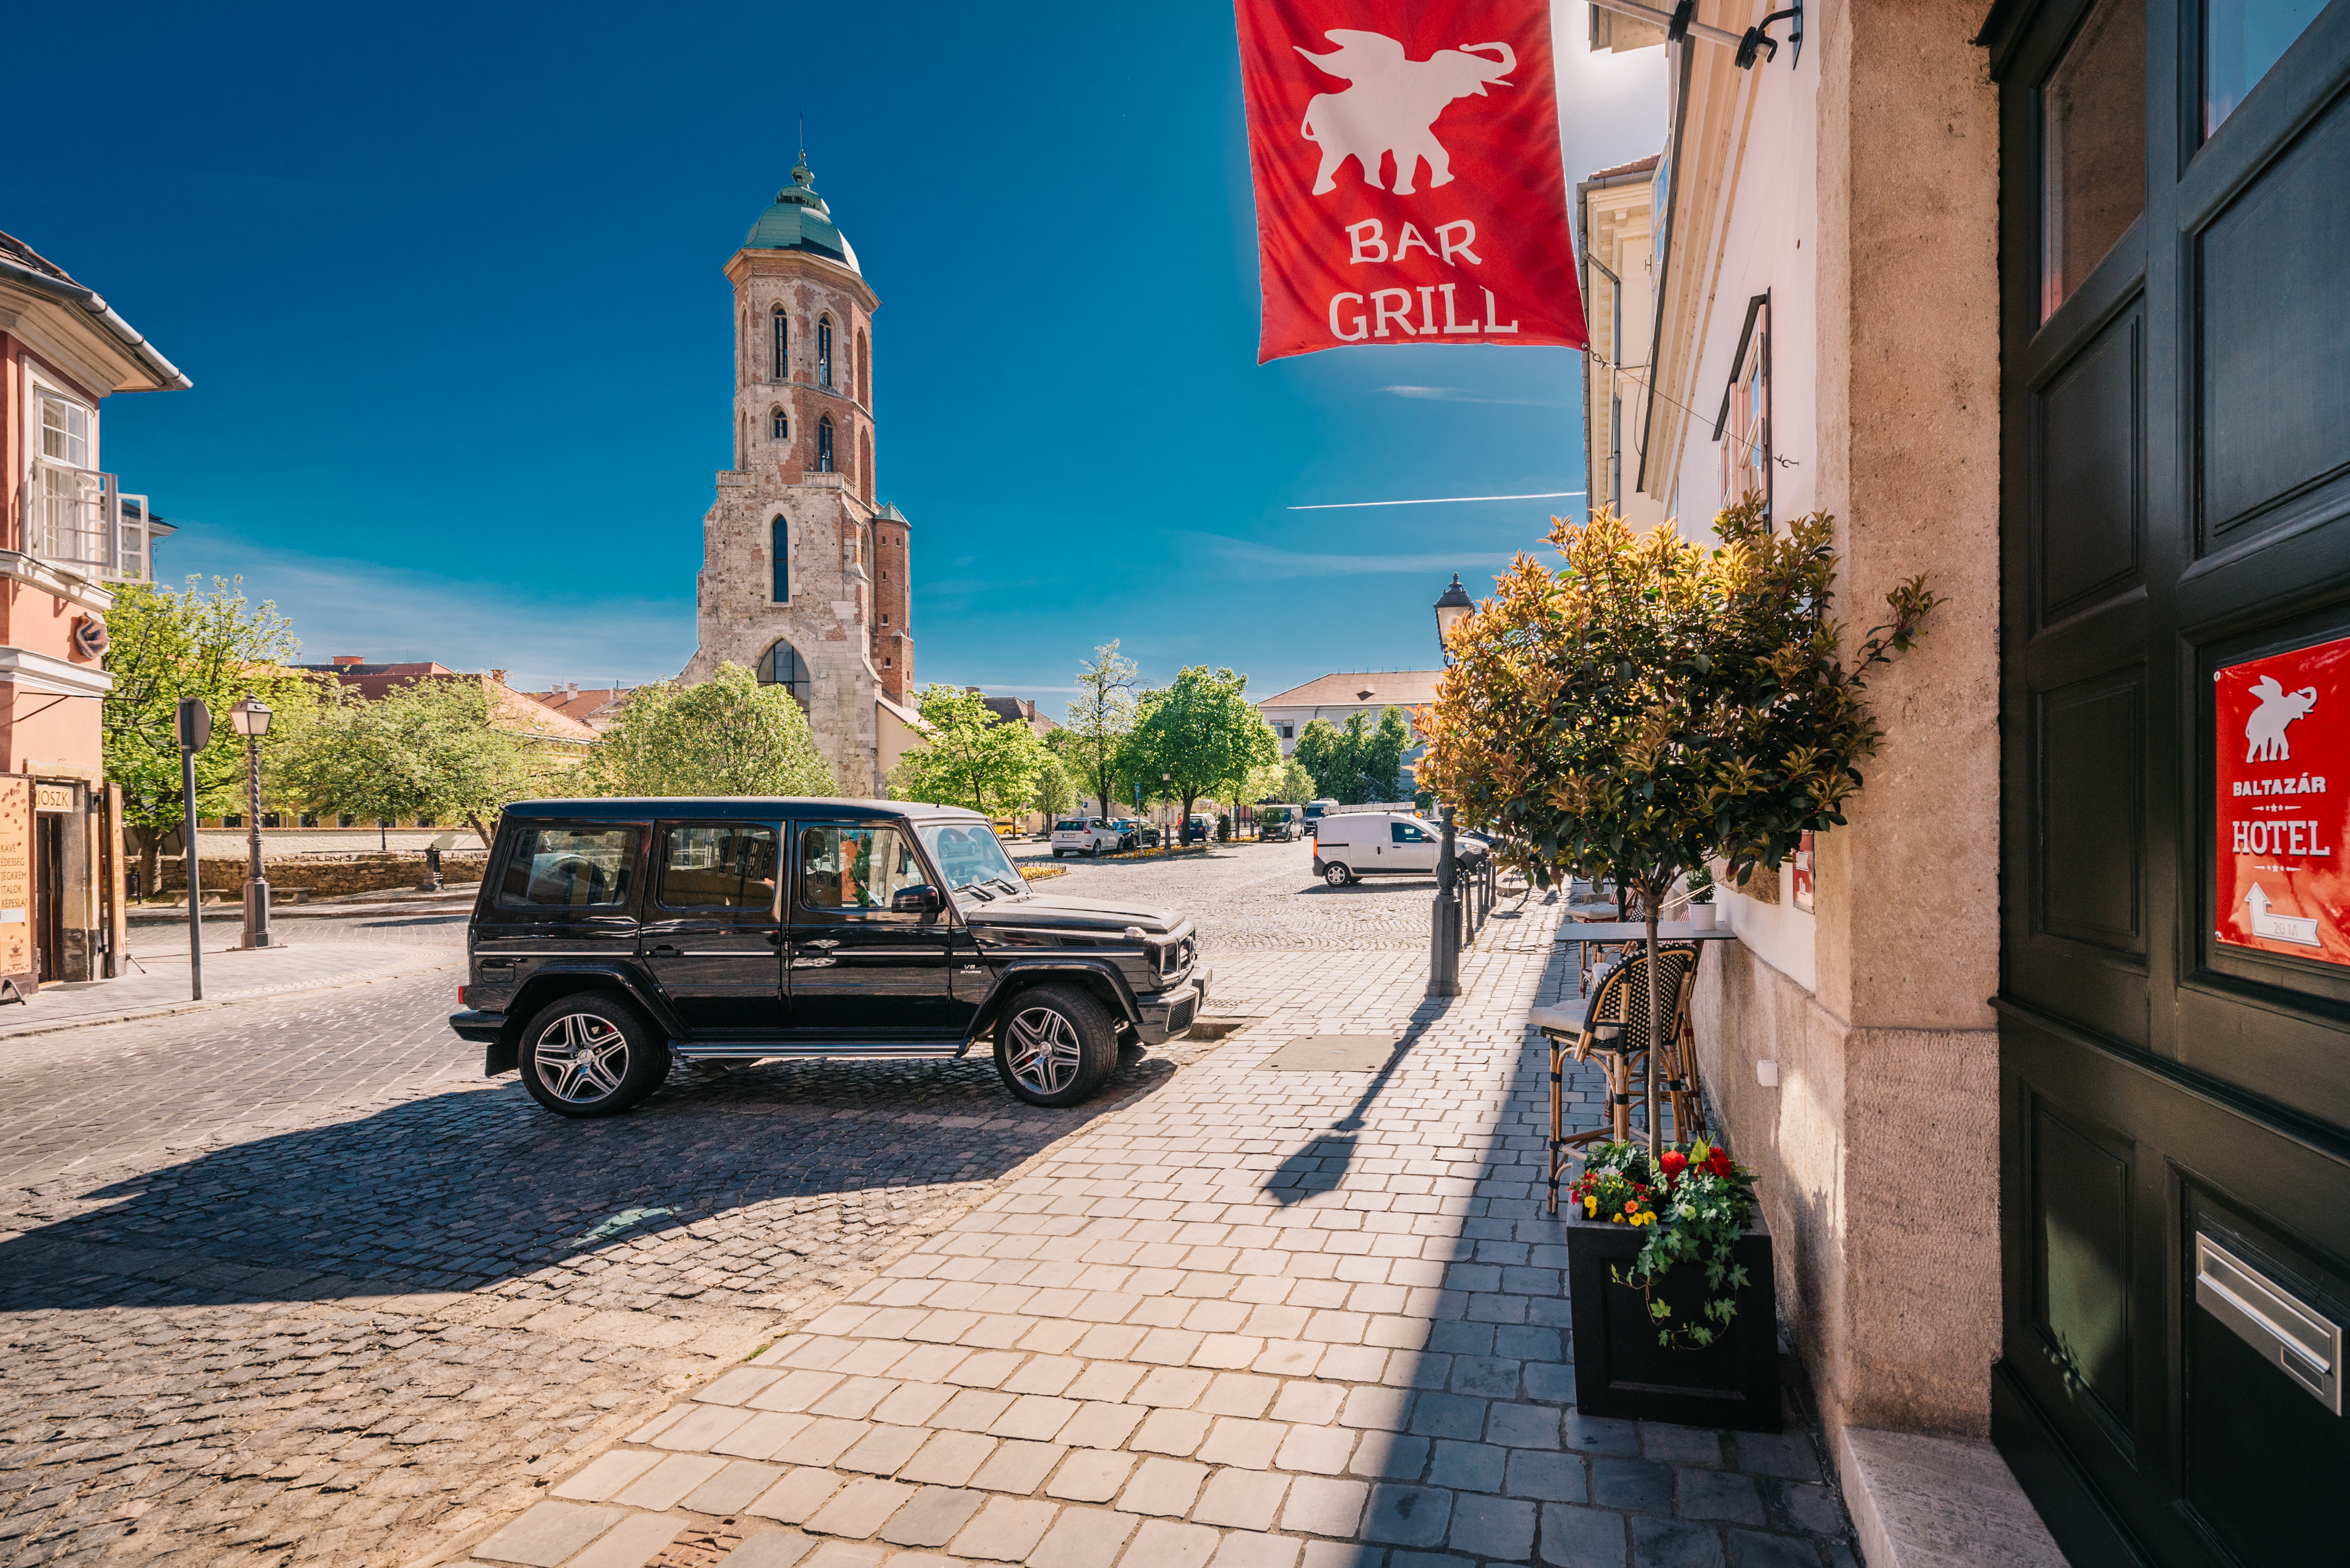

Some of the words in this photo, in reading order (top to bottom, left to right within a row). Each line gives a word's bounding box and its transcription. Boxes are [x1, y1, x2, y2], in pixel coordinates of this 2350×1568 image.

[1345, 219, 1482, 267] BAR
[1329, 283, 1518, 342] GRILL
[2233, 772, 2326, 797] BALTAZÁR
[36, 790, 69, 806] IOSZK
[2232, 821, 2331, 856] HOTEL
[1, 842, 16, 852] KÁVÉ
[1, 856, 25, 866] ÉDESSÉG
[1, 869, 27, 882] JÉGKRÉM
[1, 885, 22, 894] ITALOK
[1, 897, 28, 908] KÉPESLAP
[2273, 921, 2286, 935] 20
[2287, 923, 2298, 937] M
